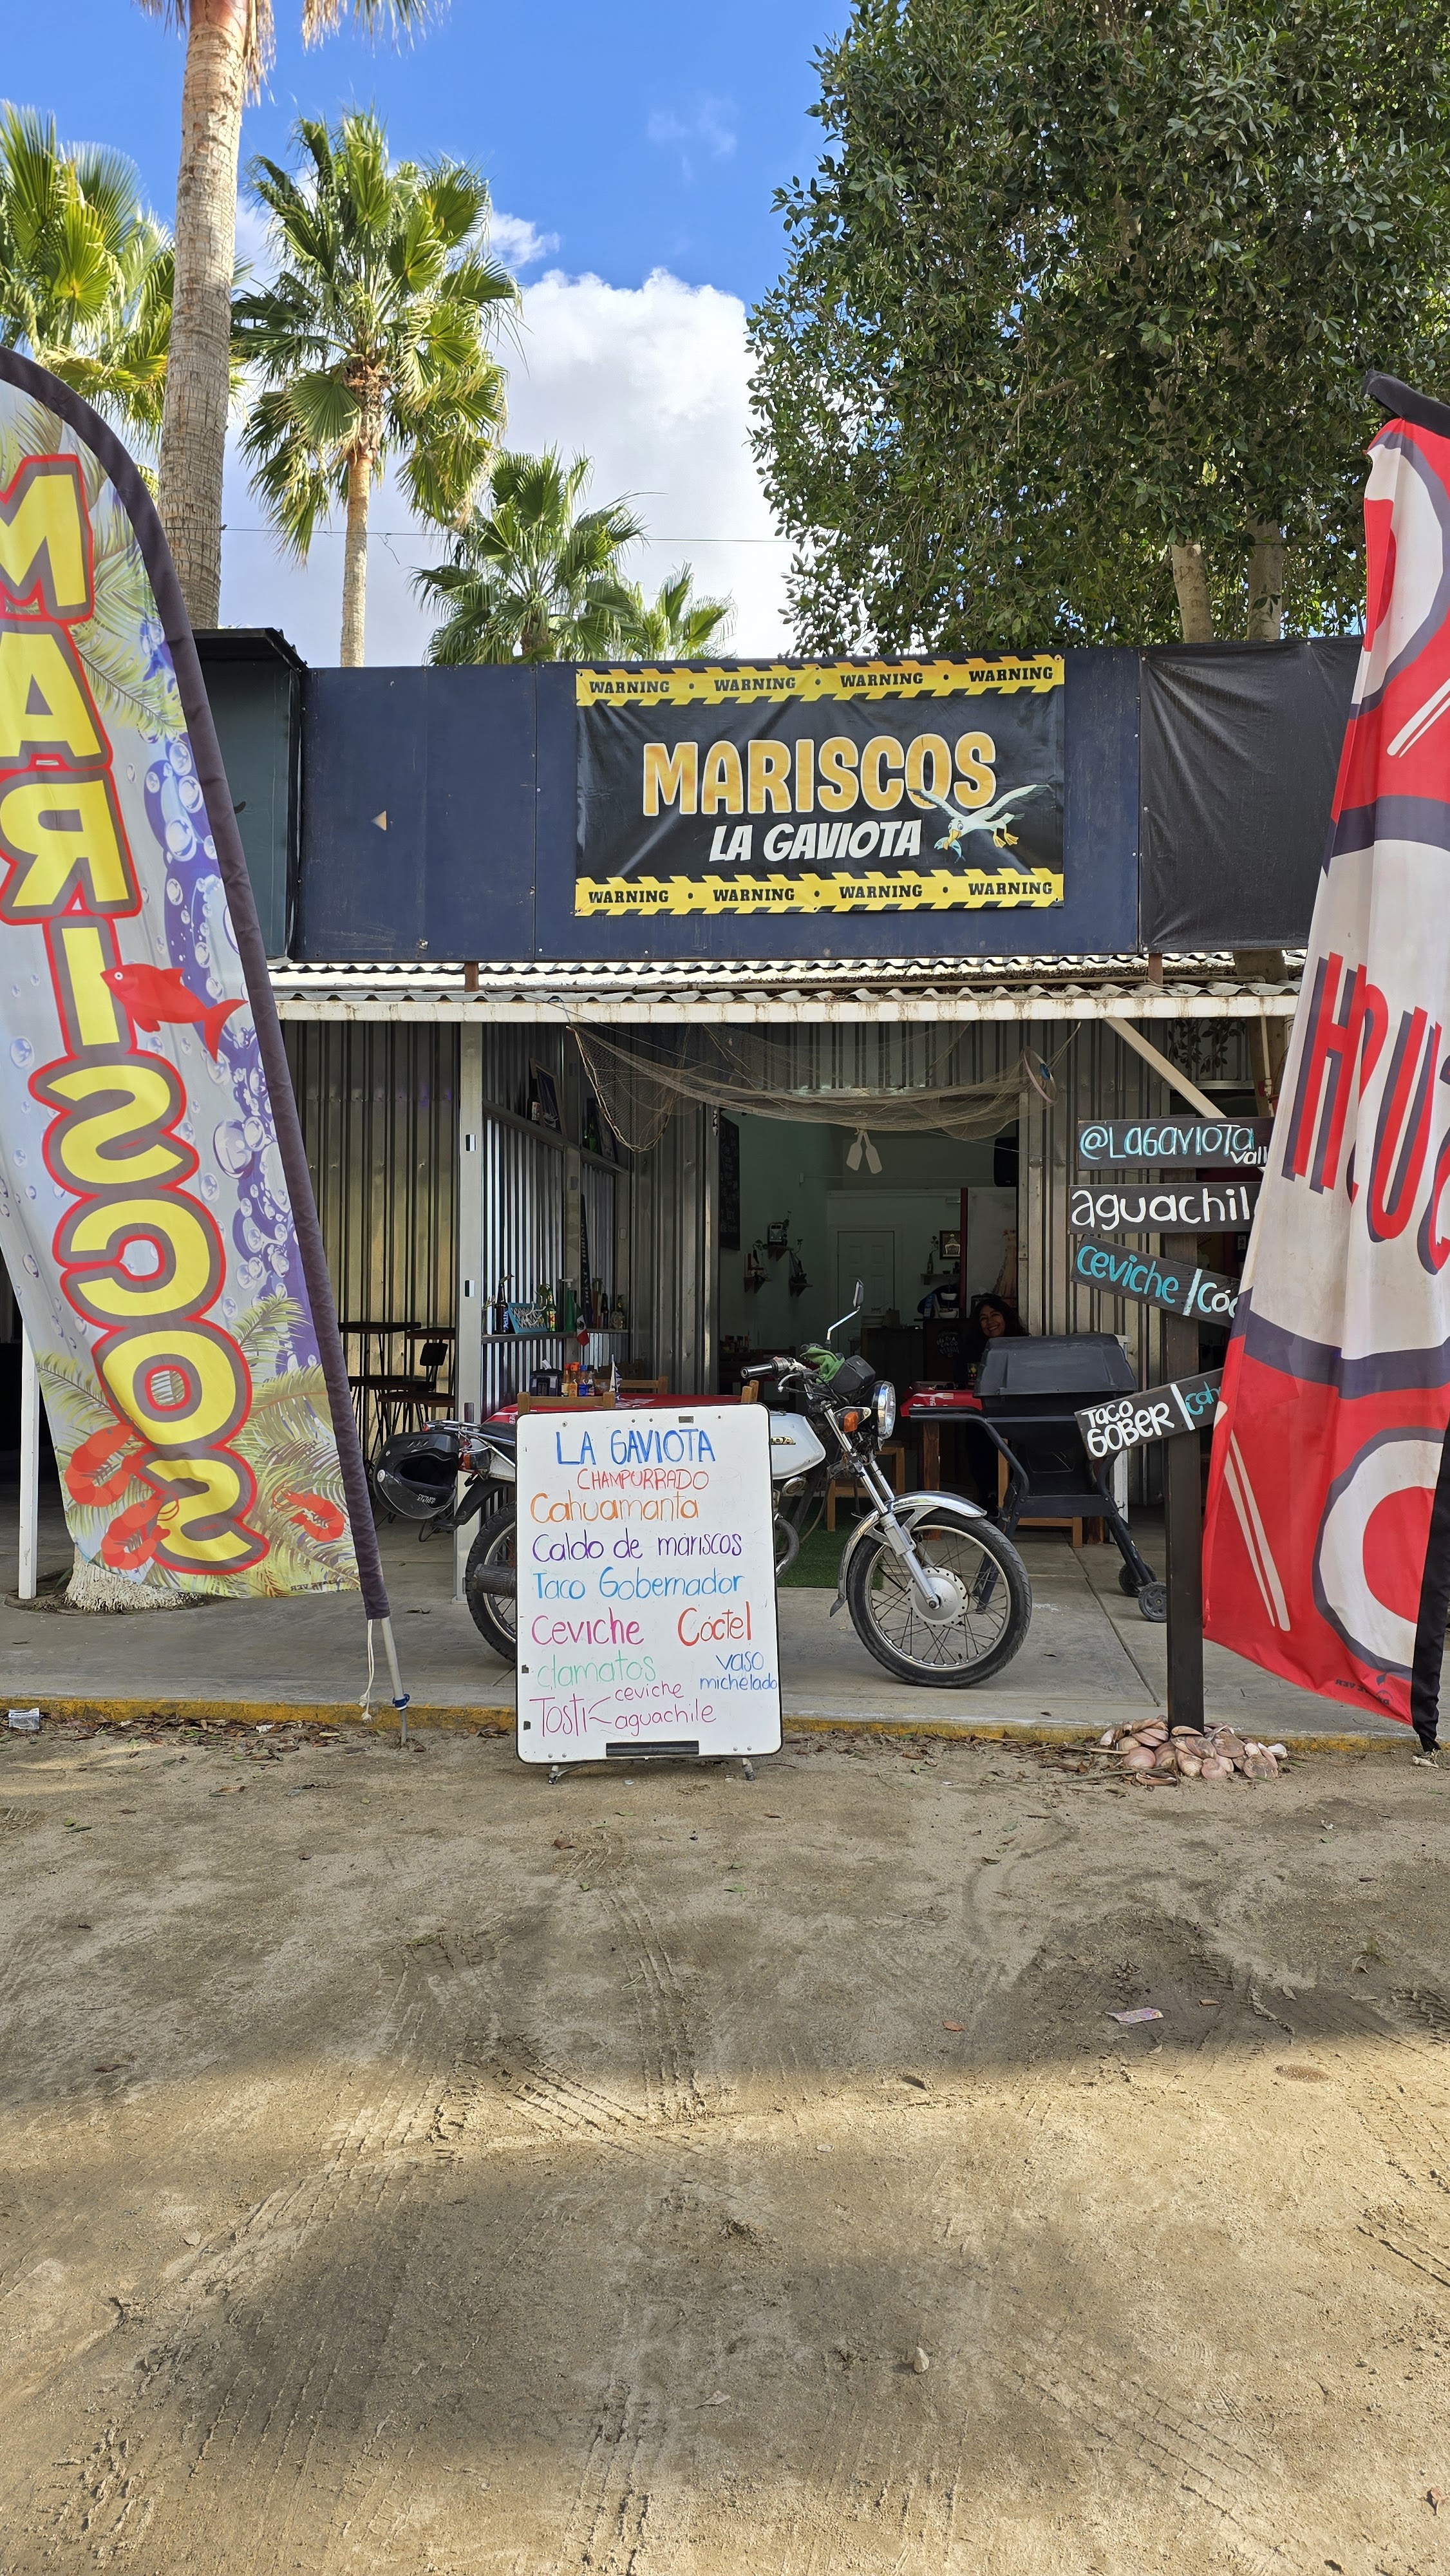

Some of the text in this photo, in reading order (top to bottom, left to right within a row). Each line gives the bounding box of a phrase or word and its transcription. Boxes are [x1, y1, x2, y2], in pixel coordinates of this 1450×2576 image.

[588, 666, 1053, 694] WARNING WARNING WARNING WARNING
[643, 731, 997, 817] MARISCOS
[709, 819, 921, 862] LA GAVIOTA
[588, 881, 1053, 904] WARNING WARNING WARNING WARNING
[1071, 1186, 1252, 1231] aguachil
[1077, 1245, 1179, 1304] ceviche
[556, 1428, 716, 1465] LA GAVIOTA
[577, 1468, 710, 1490] CHAMPURRADO
[530, 1490, 700, 1524] Cahuamanta
[532, 1527, 742, 1562] Caldo de mariscos
[532, 1566, 746, 1600] Taco Gobernador
[531, 1606, 645, 1645] Ceviche
[537, 1649, 765, 1689] clamatos vaso
[699, 1672, 778, 1691] michelado
[614, 1680, 684, 1701] ceviche
[614, 1698, 717, 1737] aguachile
